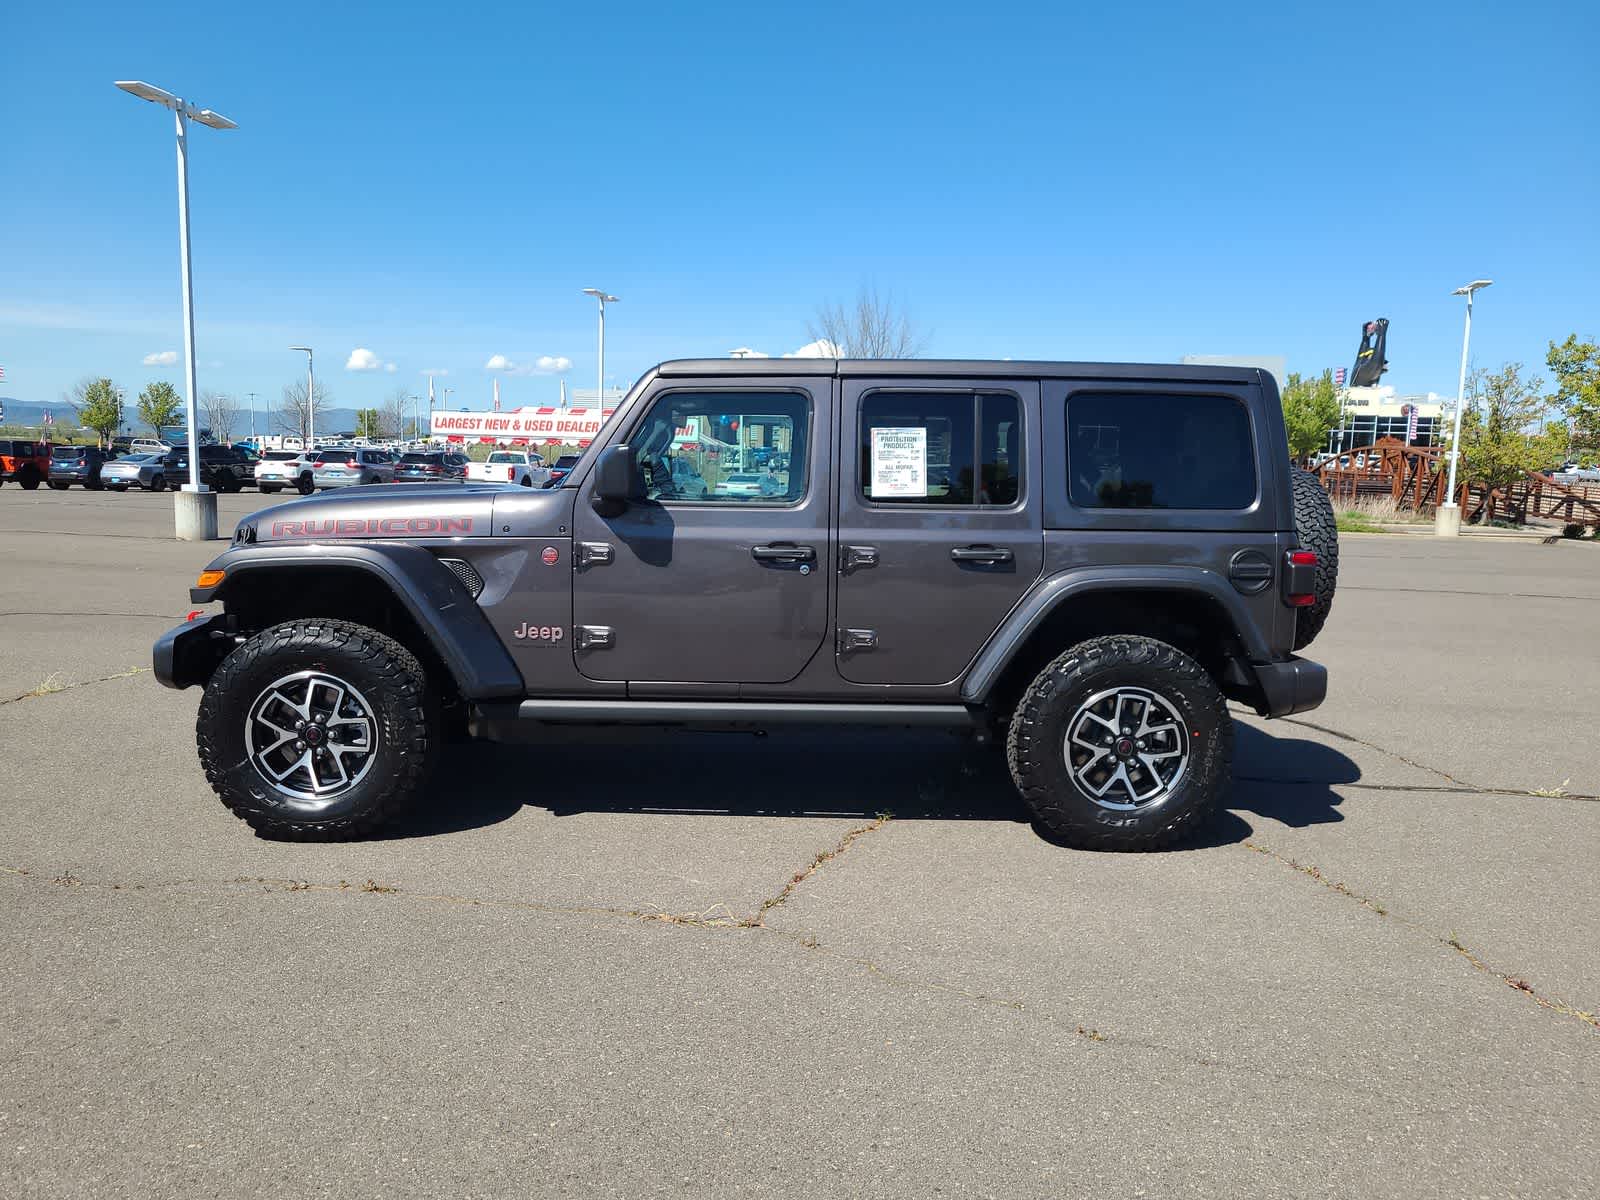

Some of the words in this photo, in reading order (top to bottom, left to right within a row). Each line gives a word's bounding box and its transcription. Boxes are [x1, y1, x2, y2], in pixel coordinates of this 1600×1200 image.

[434, 417, 483, 430] LARGEST
[485, 418, 511, 431] NEW
[512, 419, 521, 431] &
[524, 419, 553, 432] USED
[556, 420, 600, 433] DEALER
[272, 518, 473, 537] RUBICON
[513, 622, 564, 643] Jeep
